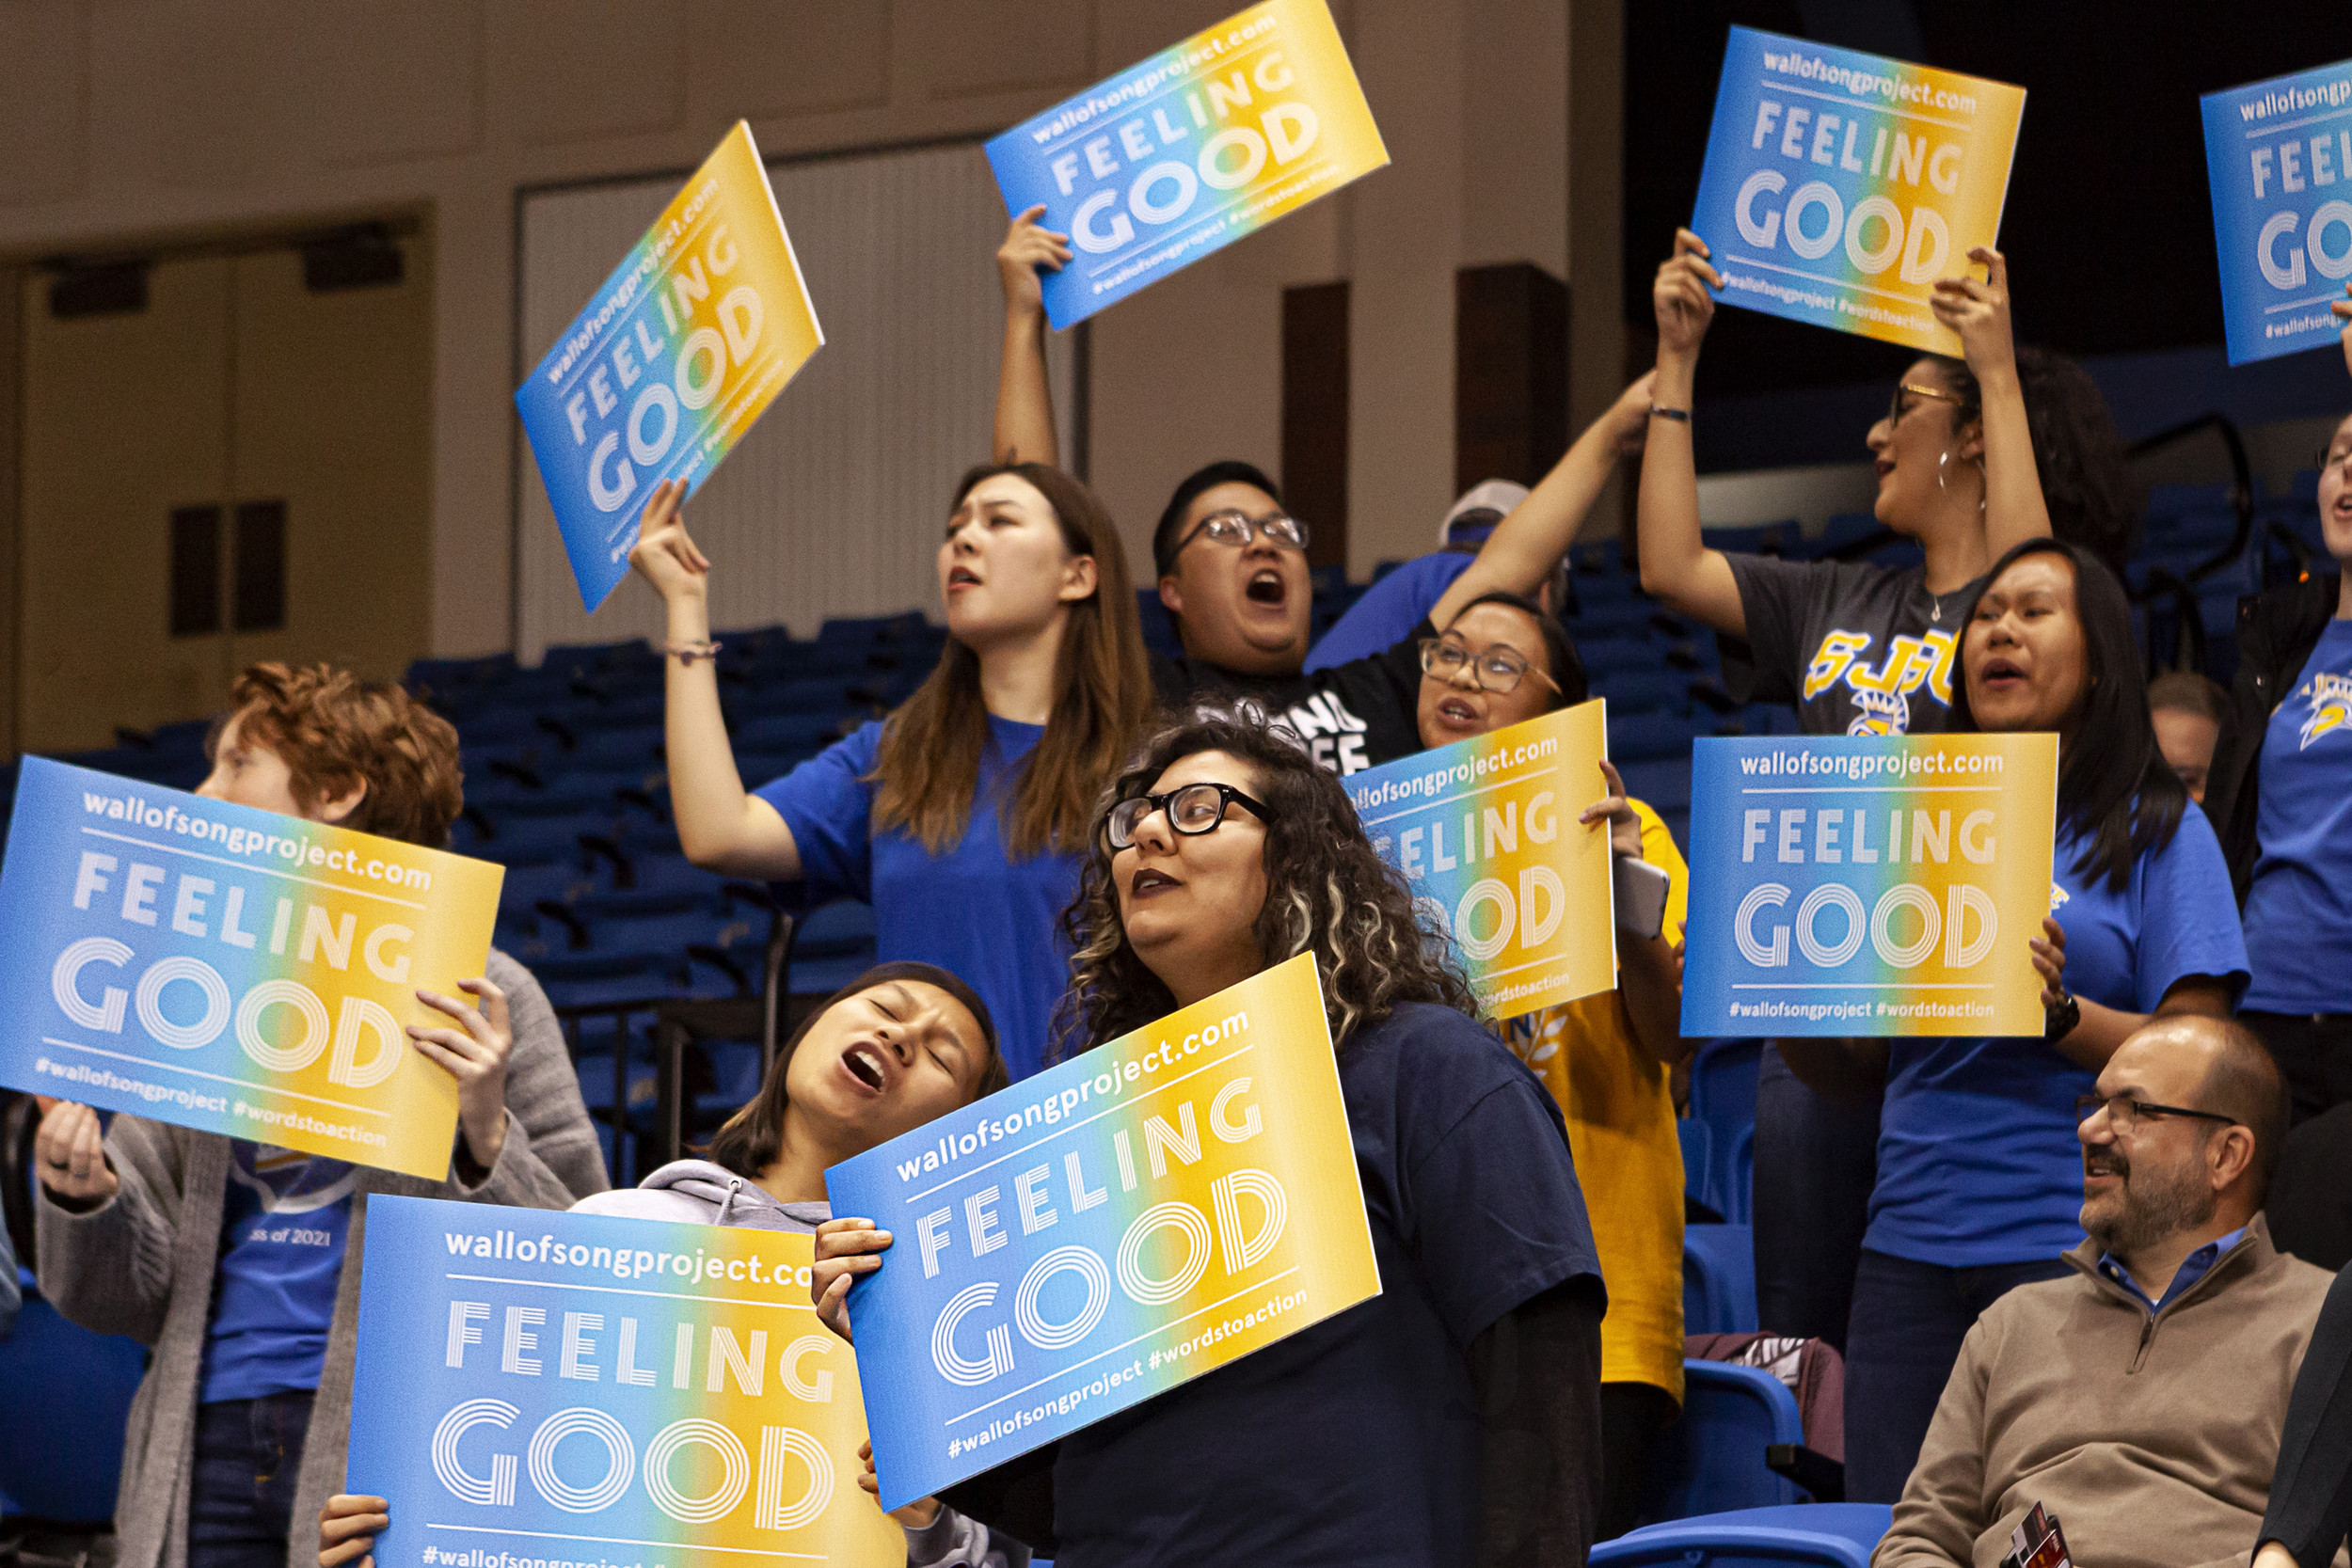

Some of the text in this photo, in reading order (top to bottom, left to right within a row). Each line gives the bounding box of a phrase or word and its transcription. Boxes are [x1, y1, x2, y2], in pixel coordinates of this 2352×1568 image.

[1032, 14, 1277, 145] wallofsongproject.com
[1051, 51, 1295, 196] FEELING
[1763, 52, 1977, 115] wallofsongproject.com
[2240, 80, 2352, 122] wallofsongp
[1071, 102, 1319, 253] GOOD
[1752, 100, 1963, 195] FEELING
[1735, 169, 1949, 284] GOOD
[565, 223, 739, 446] FEELING
[588, 284, 764, 513] GOOD
[1349, 736, 1558, 812] llofsongproject.com
[1740, 749, 2003, 779] wallofsongproject.com
[83, 788, 433, 892] wallofsongproject.com
[1374, 791, 1556, 880] ELING
[1742, 809, 1995, 863] FEELING
[73, 850, 415, 984] FEELING
[1734, 882, 1998, 969] GOOD
[52, 937, 404, 1088] GOOD
[1729, 1001, 1994, 1021] #wallofsongproject #wordstoaction
[35, 1056, 387, 1148] #wallofsongproject #wordstoaction
[897, 1009, 1249, 1182] wallofsongproject.com
[915, 1076, 1263, 1279] FEELING
[271, 1227, 291, 1243] of
[291, 1228, 331, 1247] 2021
[445, 1229, 813, 1289] wallofsongproject.co
[931, 1168, 1287, 1386] GOOD
[446, 1300, 835, 1403] FEELING
[947, 1289, 1308, 1459] #wallofsongproject #wordstoaction
[431, 1398, 834, 1530] GOOD
